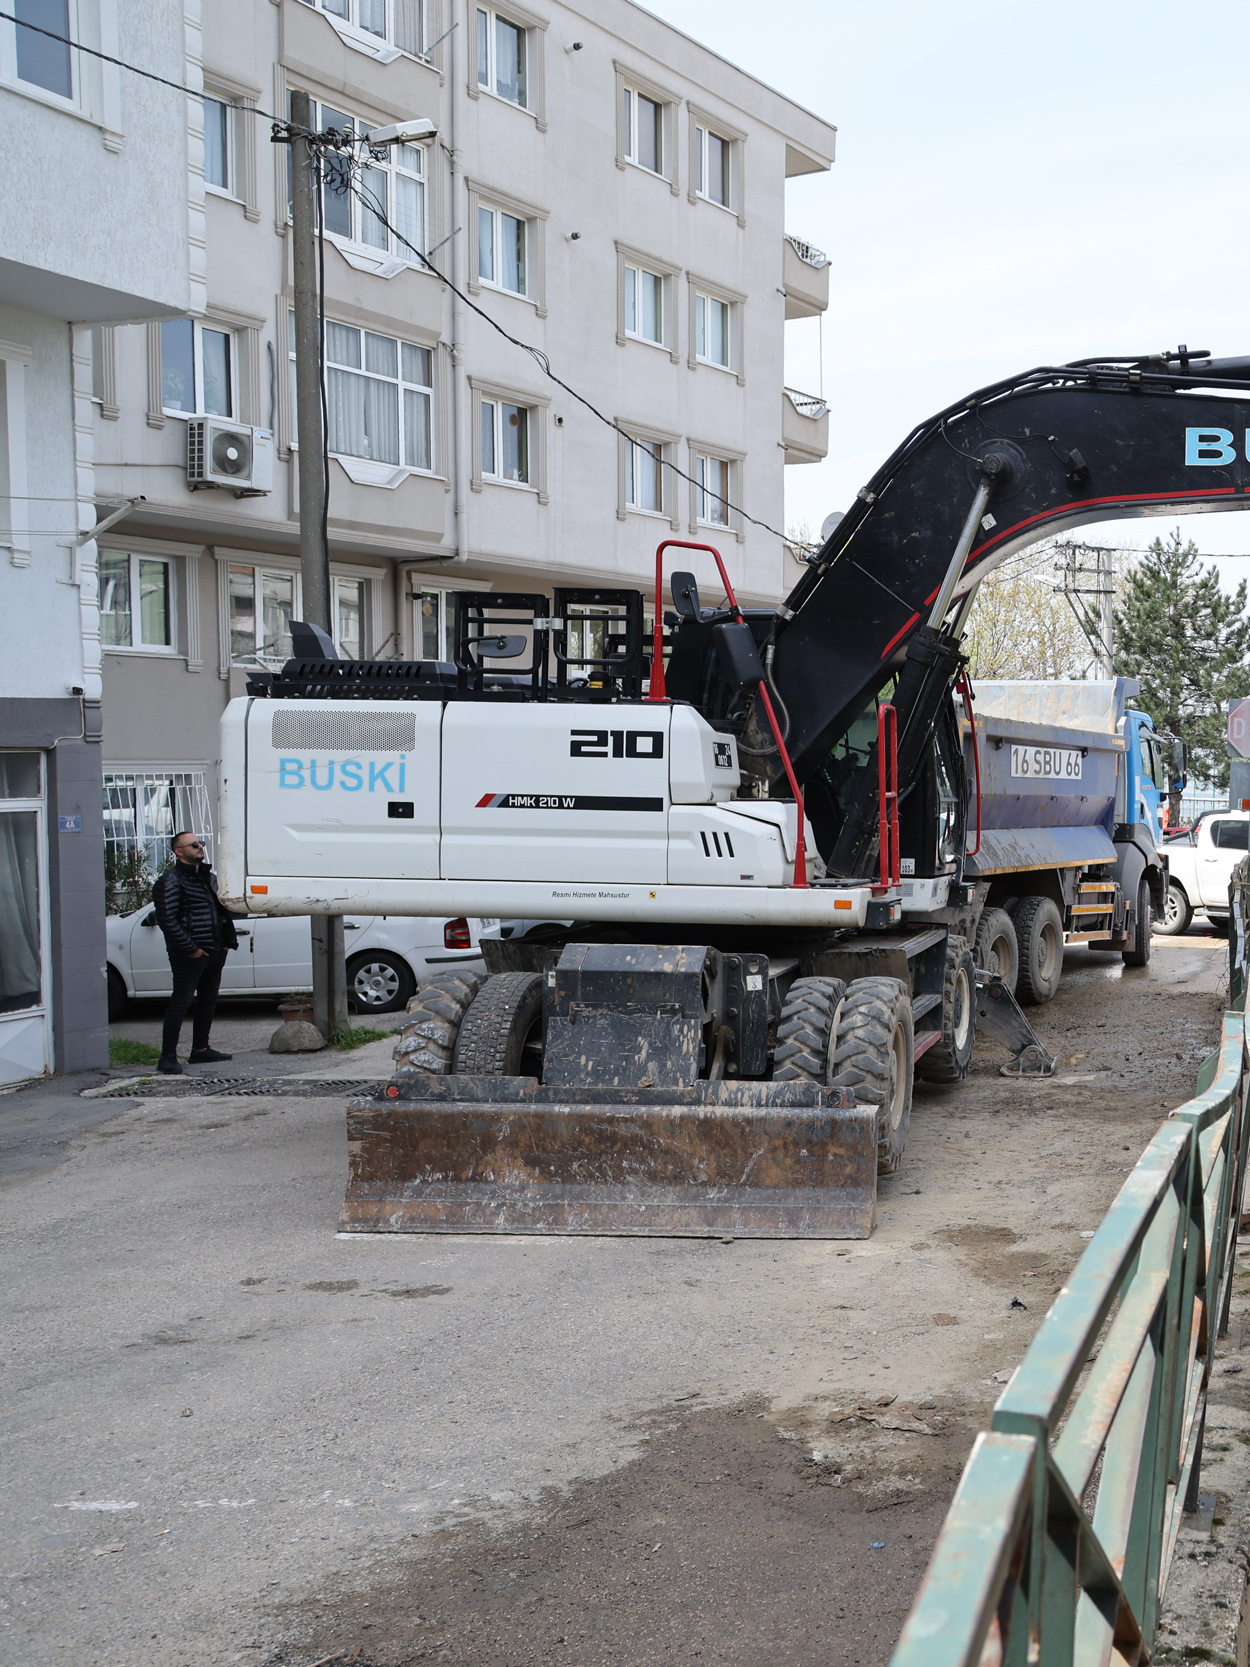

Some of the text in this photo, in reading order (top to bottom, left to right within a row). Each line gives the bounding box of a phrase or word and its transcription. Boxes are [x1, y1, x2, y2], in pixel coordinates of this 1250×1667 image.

[570, 729, 664, 759] 210
[1013, 748, 1080, 777] 16 SBU 66
[508, 796, 575, 808] HMK 210 W
[65, 820, 75, 829] 4A
[598, 891, 630, 899] Mahsustur
